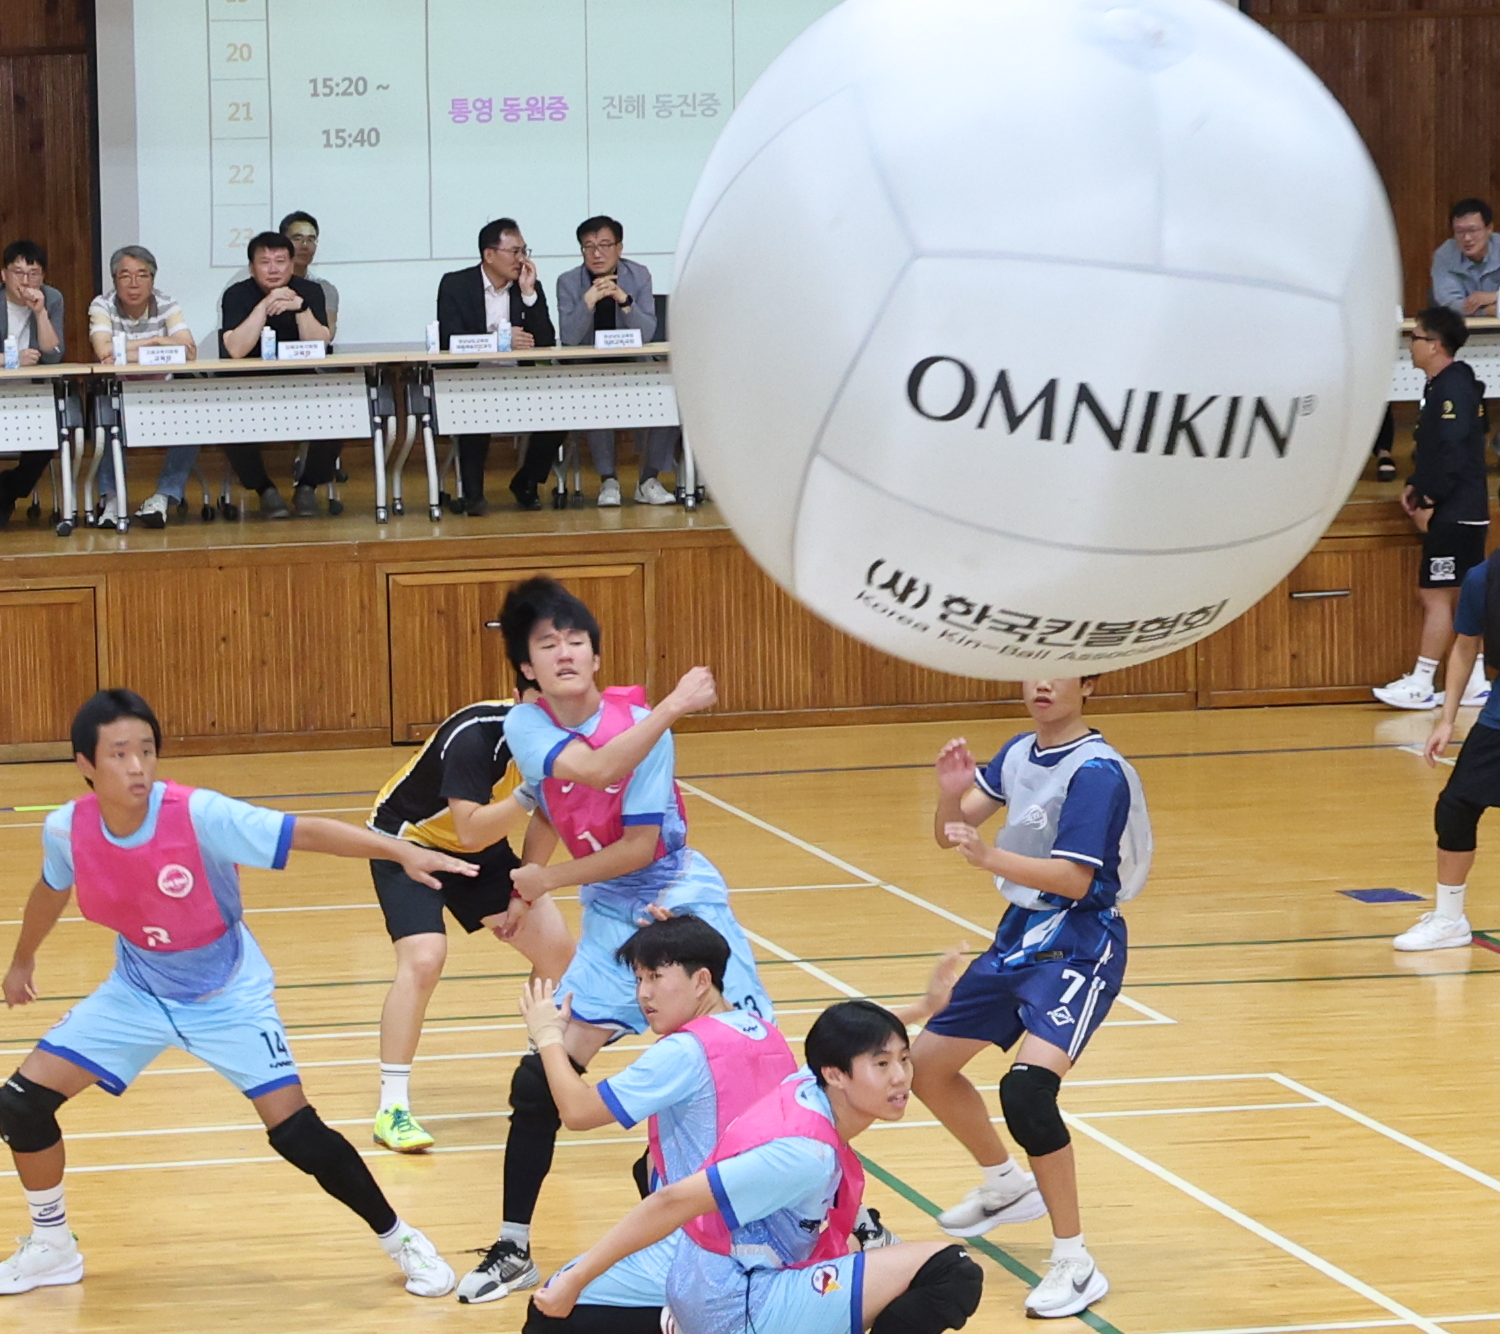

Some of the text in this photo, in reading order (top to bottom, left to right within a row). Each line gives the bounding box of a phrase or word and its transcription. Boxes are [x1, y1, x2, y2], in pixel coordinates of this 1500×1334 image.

[226, 43, 253, 63] 20
[308, 76, 369, 98] 15:20
[227, 101, 253, 122] 21
[447, 94, 570, 124] 통영 동원중
[601, 92, 721, 120] 진해 동진중
[321, 127, 381, 149] 15:40
[227, 164, 255, 185] 22
[855, 589, 929, 634] Korea
[865, 557, 1231, 648] (사) 한국킨볼협회
[1061, 968, 1086, 1004] 7
[259, 1030, 290, 1060] 14
